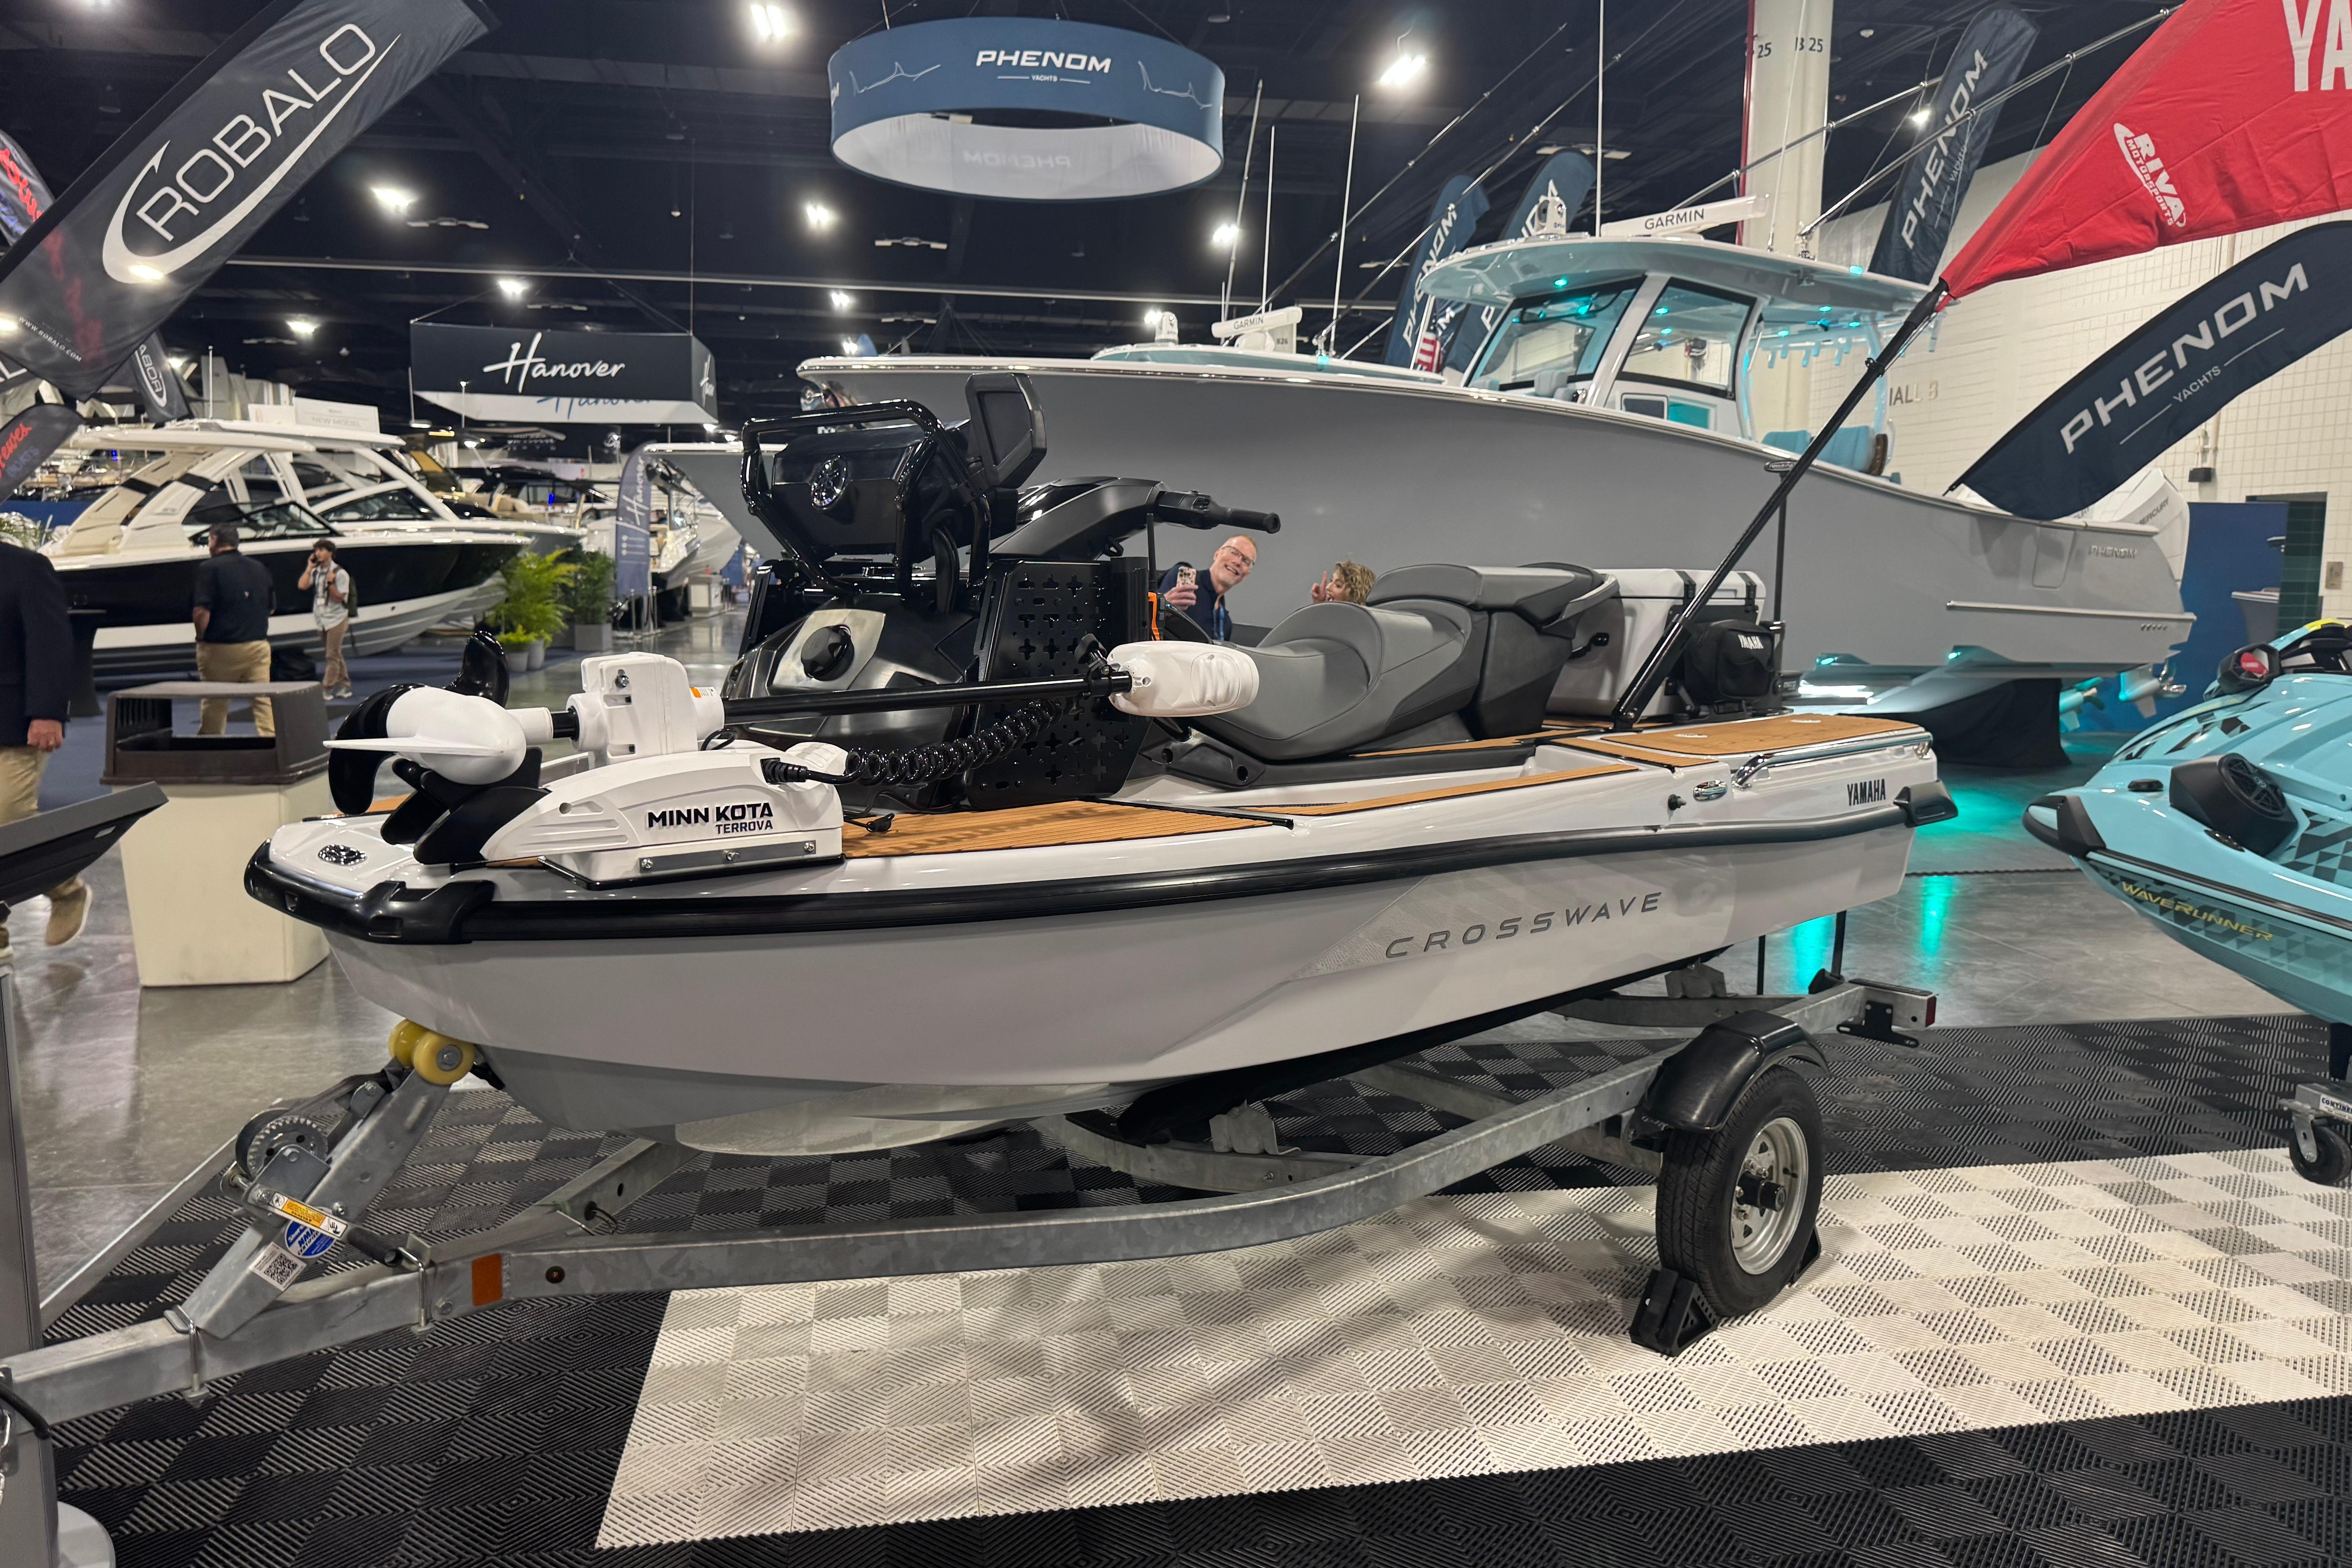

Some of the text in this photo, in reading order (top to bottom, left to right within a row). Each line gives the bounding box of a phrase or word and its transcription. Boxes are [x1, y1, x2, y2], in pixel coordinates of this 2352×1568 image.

[1757, 42, 1772, 59] 25
[1809, 37, 1823, 52] 25
[976, 50, 1111, 73] PHENOM
[136, 23, 376, 241] ROBALO
[1902, 49, 1988, 249] PHENOM
[2126, 139, 2174, 226] MOTORSPORTS
[2133, 133, 2184, 222] RIVA
[1644, 209, 1705, 230] GARMIN
[1234, 317, 1264, 329] GARMIN
[19, 316, 82, 362] WWW.ROBALO.COM
[483, 332, 625, 393] Hanover
[2060, 262, 2309, 455] PHENOM
[2173, 365, 2221, 404] YACHTS
[2135, 497, 2169, 525] ERCURY
[1738, 634, 1764, 649] YAMAHA
[1847, 779, 1885, 806] YAMAHA
[648, 803, 773, 828] MINN KOTA
[715, 820, 773, 834] TERROVA
[1386, 892, 1661, 959] CROSSWAVE
